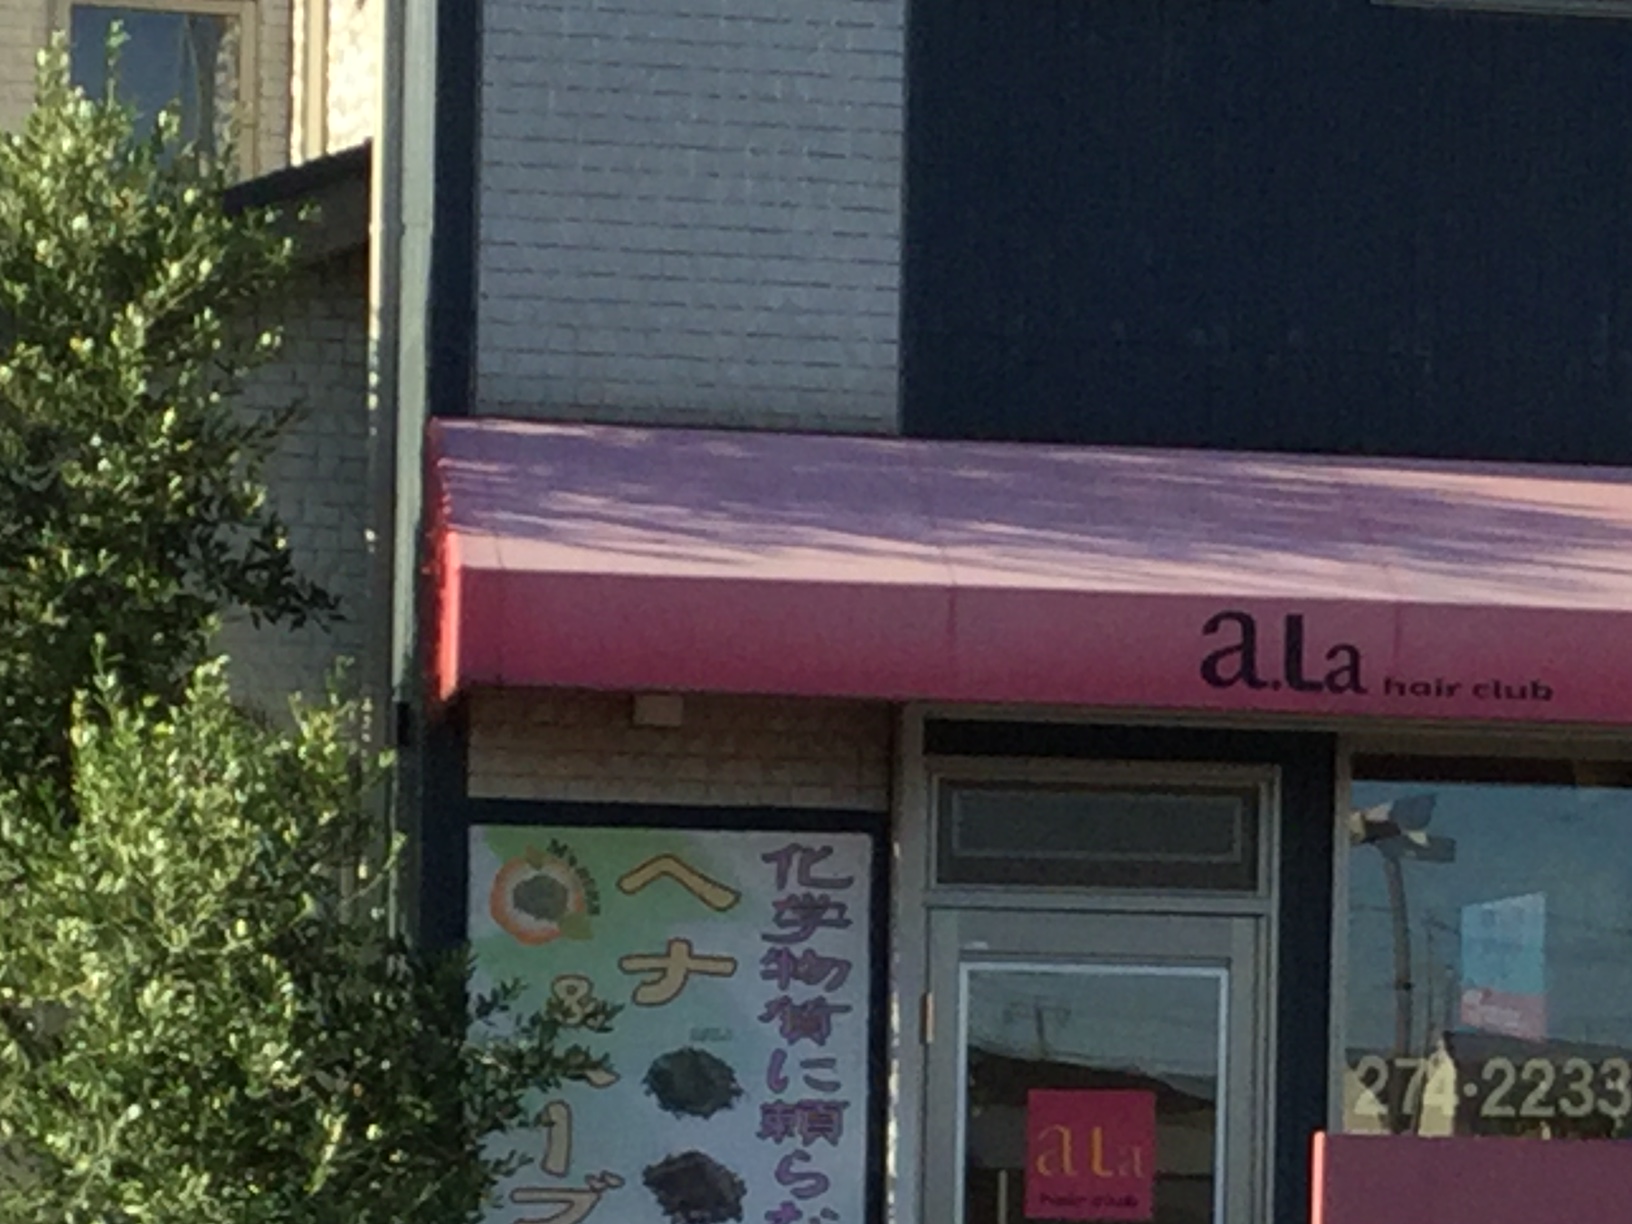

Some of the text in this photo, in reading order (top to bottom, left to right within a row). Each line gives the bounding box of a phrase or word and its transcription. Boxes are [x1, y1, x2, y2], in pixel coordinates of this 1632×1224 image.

[1383, 677, 1463, 699] hair
[1471, 678, 1554, 701] club
[616, 852, 742, 1006] ヘナ
